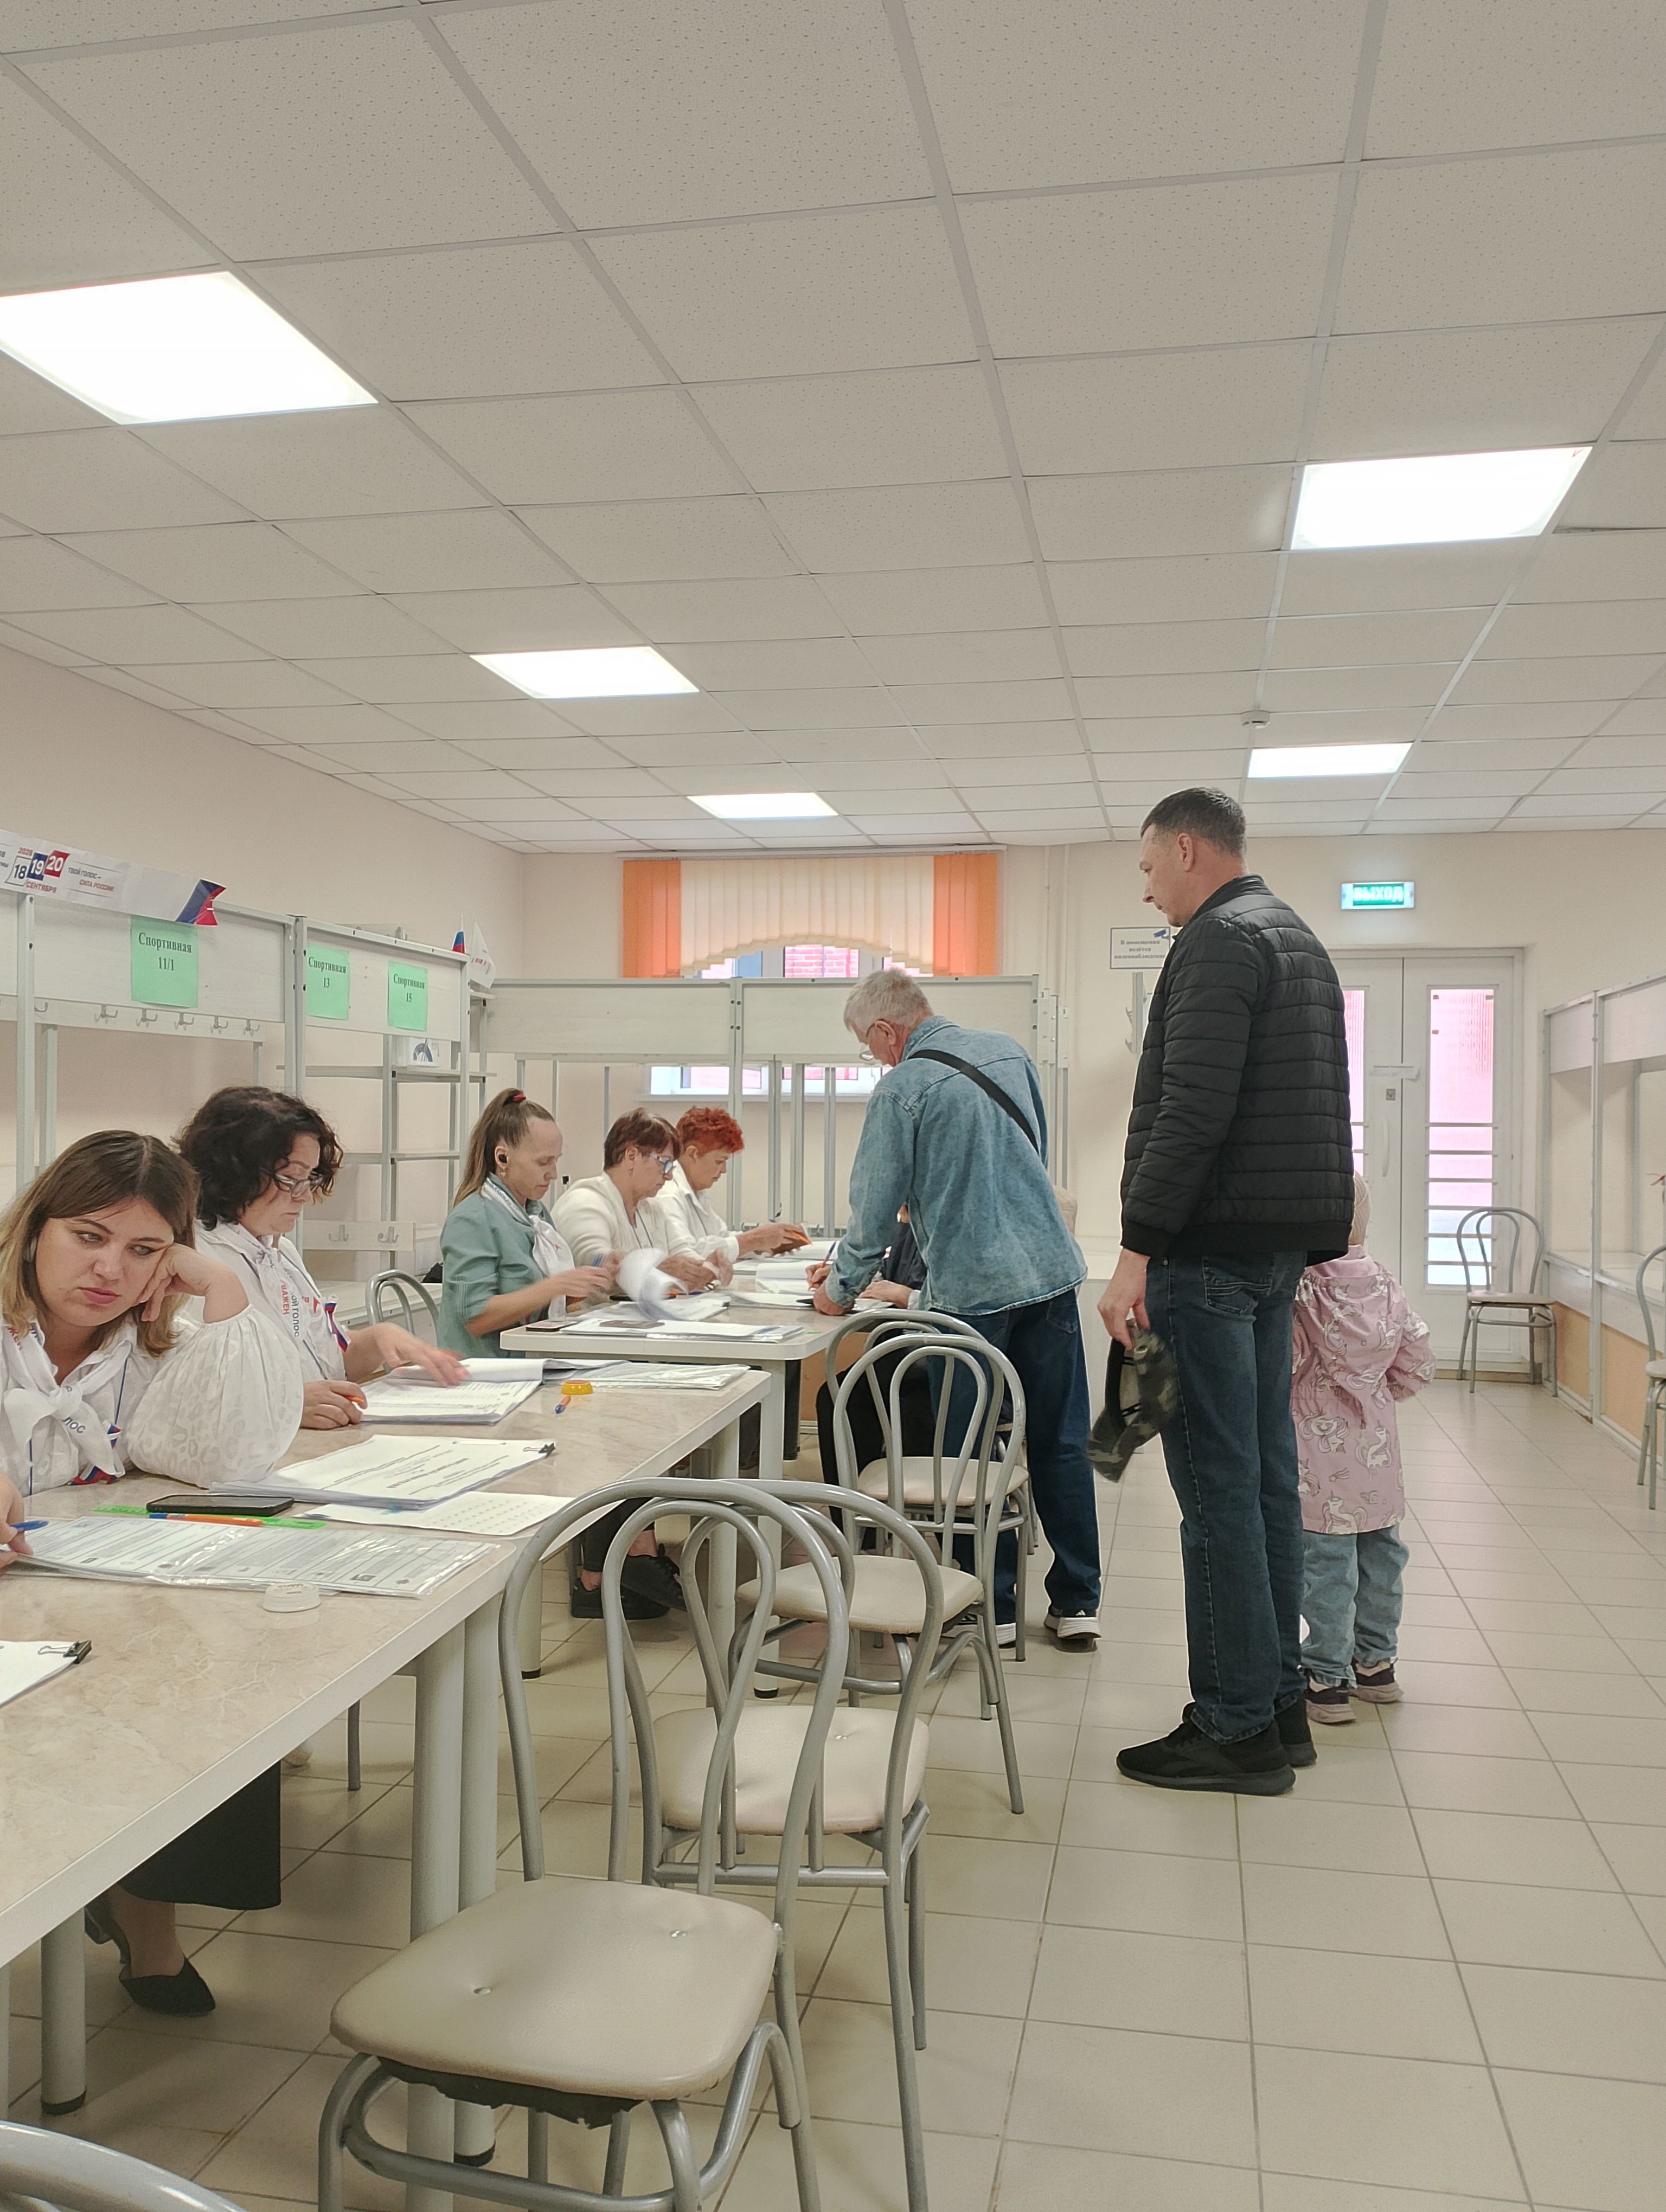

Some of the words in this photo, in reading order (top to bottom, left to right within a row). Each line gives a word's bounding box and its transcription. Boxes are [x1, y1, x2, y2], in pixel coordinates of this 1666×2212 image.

[14, 864, 27, 879] 18
[30, 859, 44, 875] 19
[46, 856, 63, 872] 20
[68, 867, 81, 875] ТВОЙ
[81, 870, 98, 879] ГОЛОС
[26, 881, 57, 893] СЕНТЯБРЯ
[1354, 886, 1404, 903] ВЫХОД
[138, 932, 191, 953] Спортивная
[158, 956, 174, 971] 11/1
[309, 956, 347, 974] Спортивная
[323, 977, 330, 988] 13
[393, 973, 425, 989] Спортивная
[406, 992, 412, 1002] 15
[291, 1307, 300, 1338] ГОЛОС
